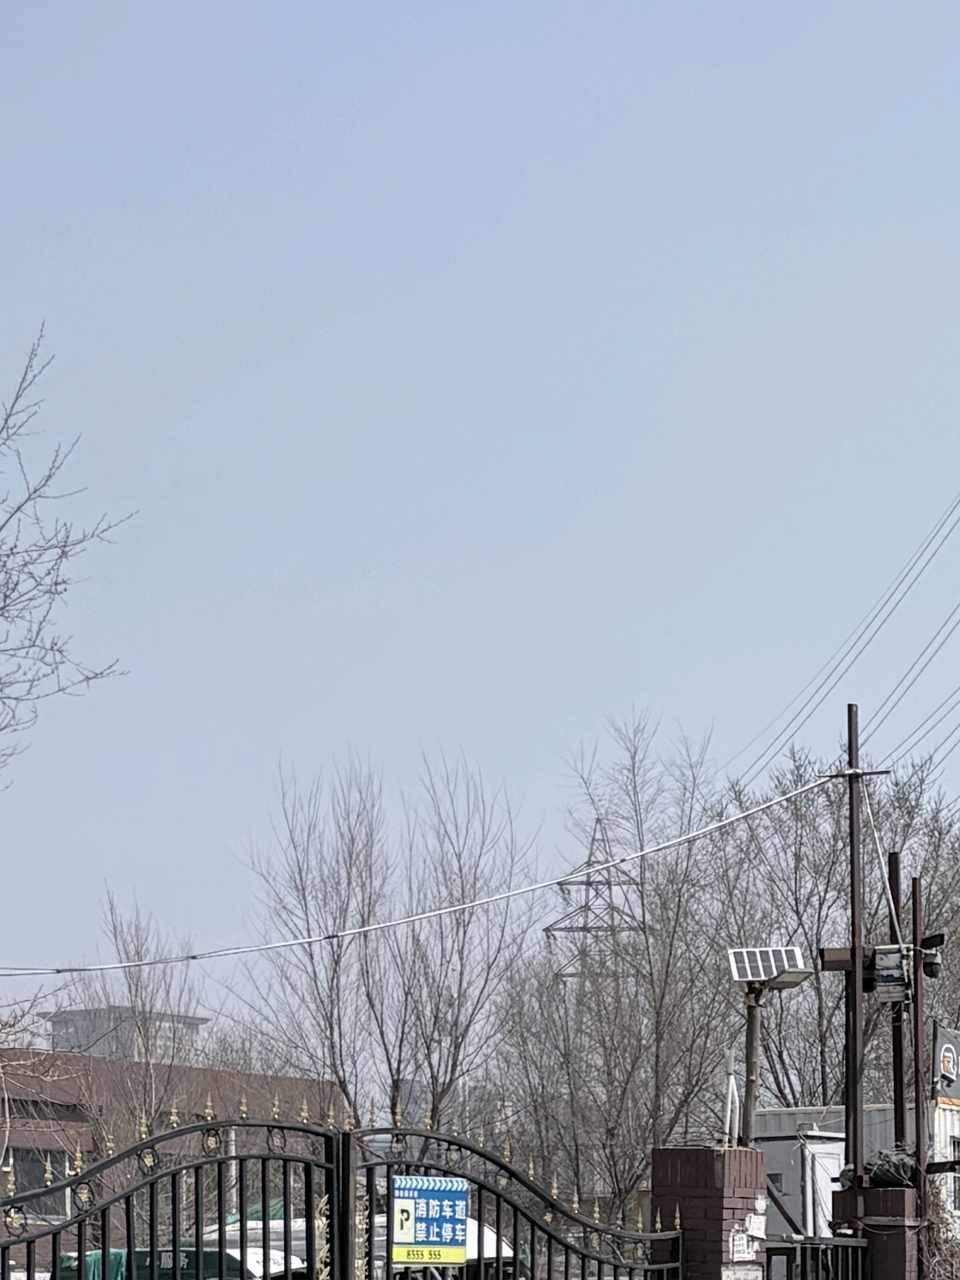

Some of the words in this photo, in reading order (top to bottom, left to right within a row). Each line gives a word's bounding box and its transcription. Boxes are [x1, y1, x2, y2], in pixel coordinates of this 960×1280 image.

[400, 1208, 410, 1230] P
[415, 1199, 466, 1219] 消防车道
[415, 1222, 466, 1242] 禁止停车
